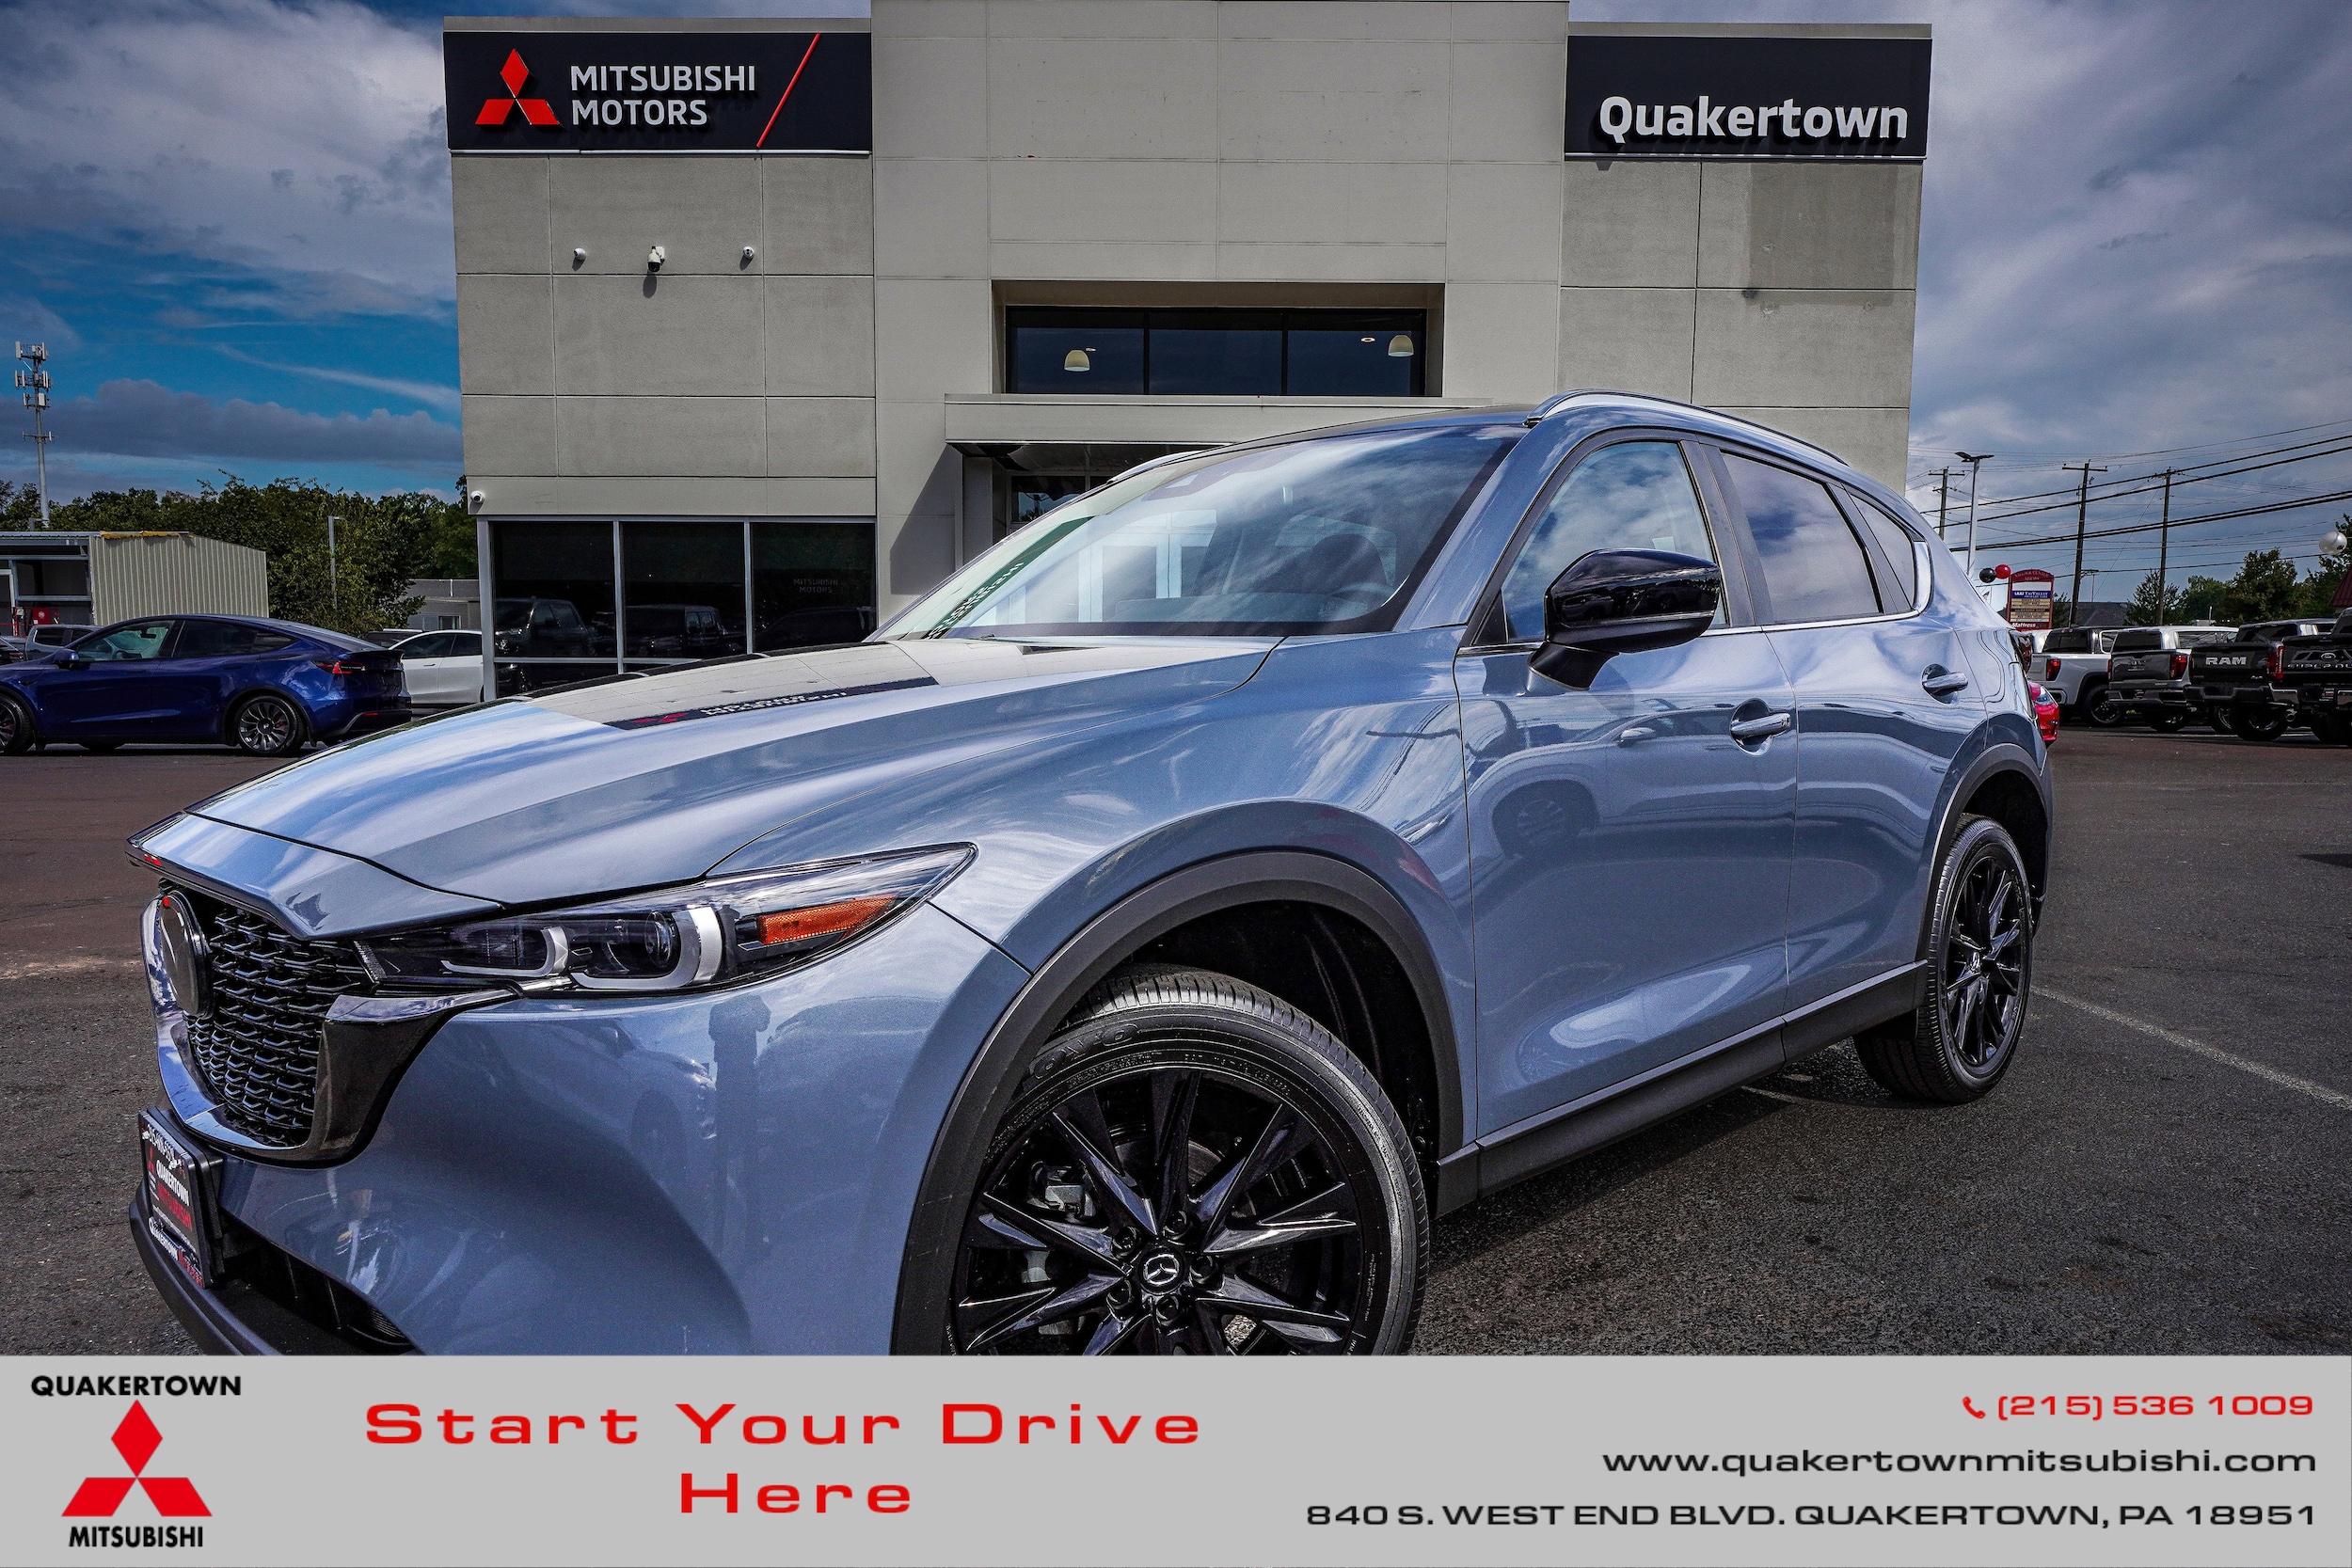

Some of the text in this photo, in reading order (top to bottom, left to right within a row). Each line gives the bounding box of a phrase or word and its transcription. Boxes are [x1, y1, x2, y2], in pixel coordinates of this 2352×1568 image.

[570, 65, 755, 91] MITSUBISHI
[572, 100, 707, 126] MOTORS
[1599, 95, 1909, 144] Quakertown
[2205, 657, 2248, 666] RAM
